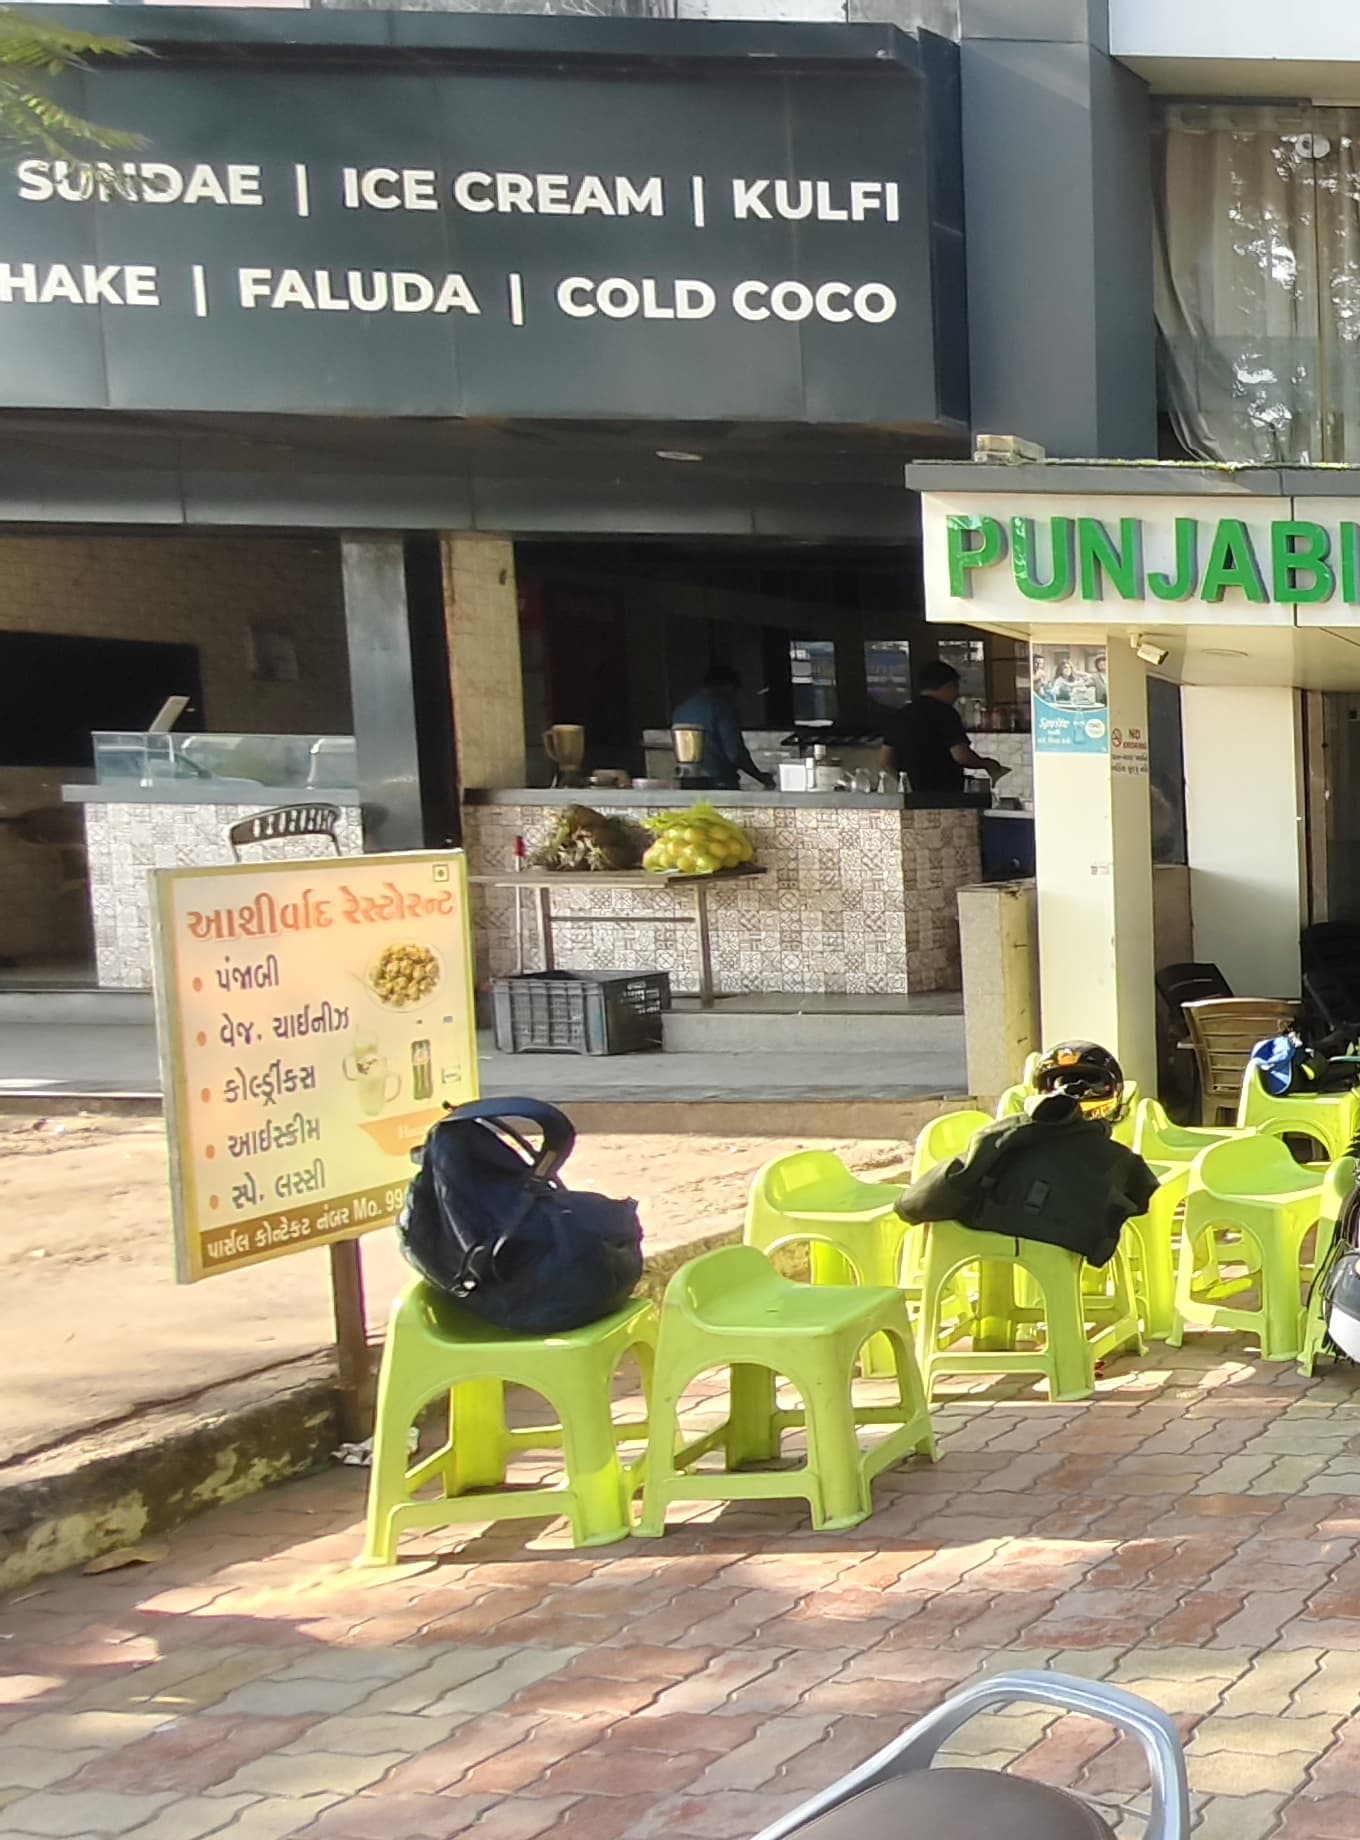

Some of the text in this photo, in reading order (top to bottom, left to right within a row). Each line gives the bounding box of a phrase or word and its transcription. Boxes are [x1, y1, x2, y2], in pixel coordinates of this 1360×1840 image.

[16, 159, 263, 207] SUNDAE
[343, 168, 437, 212] ICE
[452, 171, 664, 218] CREAM
[734, 178, 901, 223] KULFI
[0, 262, 160, 308] HAKE
[239, 267, 480, 316] FALUDA
[557, 276, 717, 322] COLD
[732, 280, 897, 325] COCO
[945, 514, 1360, 608] PUNJABI
[186, 886, 334, 941] આશીર્વાદ
[216, 954, 279, 991] પંજાબી
[353, 1197, 382, 1223] Mo.
[385, 1188, 406, 1212] 99
